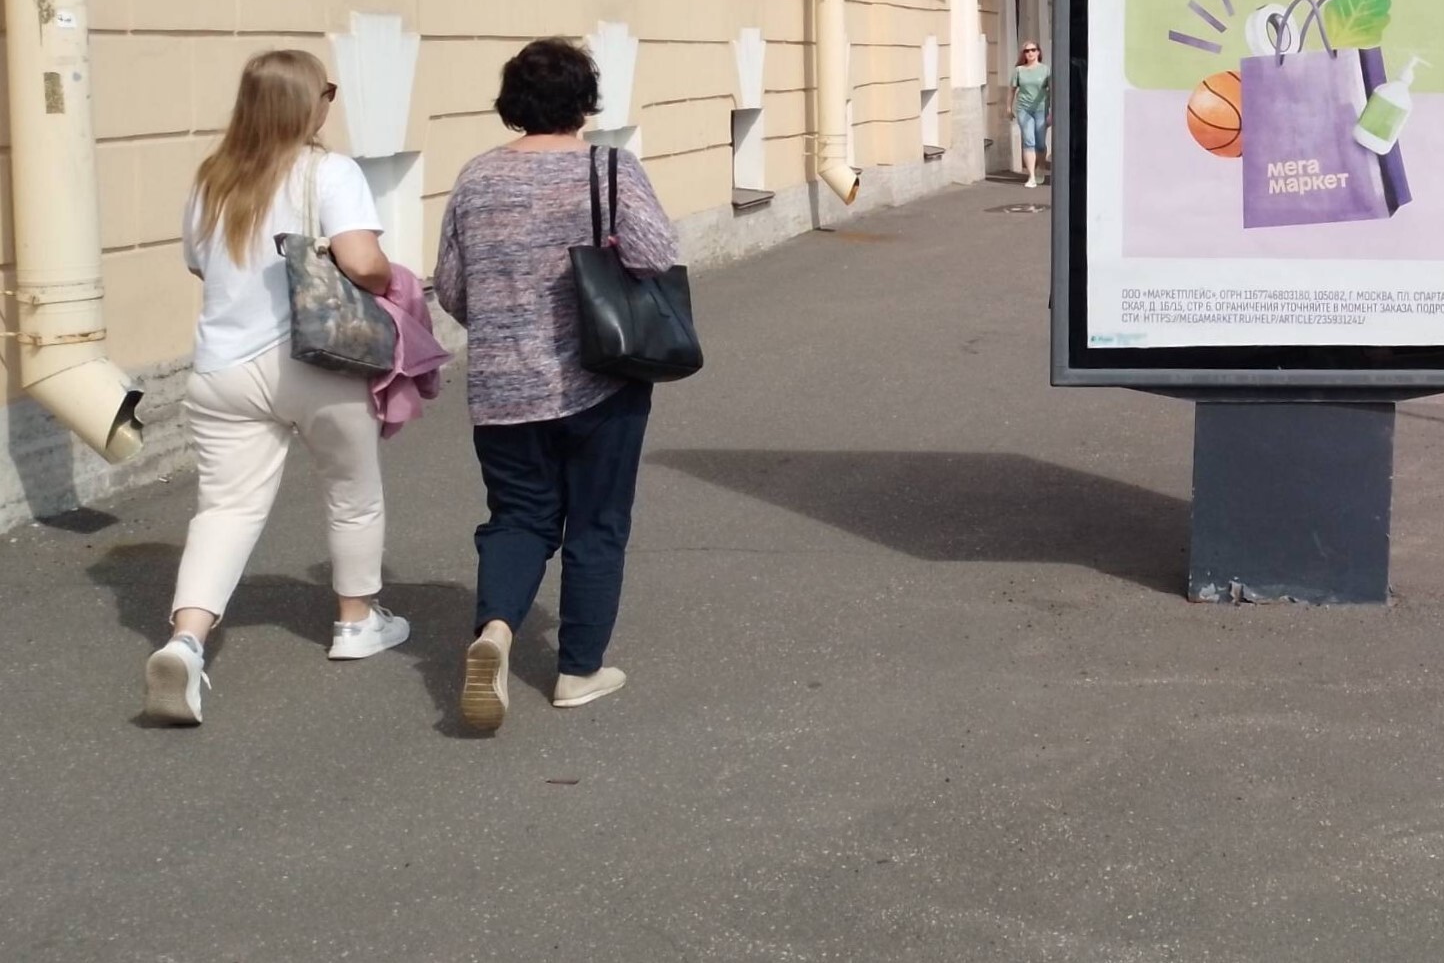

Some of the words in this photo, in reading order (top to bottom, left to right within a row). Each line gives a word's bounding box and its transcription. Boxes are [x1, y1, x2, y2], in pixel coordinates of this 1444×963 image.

[1267, 159, 1320, 178] мега
[1269, 173, 1349, 195] маркет
[1121, 288, 1141, 299] ООО
[1219, 289, 1242, 300] ОГРН
[1215, 301, 1279, 312] ОГРАНИЧЕНИЯ
[1280, 301, 1331, 313] УТОЧНЯЙТЕ
[1333, 303, 1339, 313] В
[1340, 303, 1378, 313] МОМЕНТ
